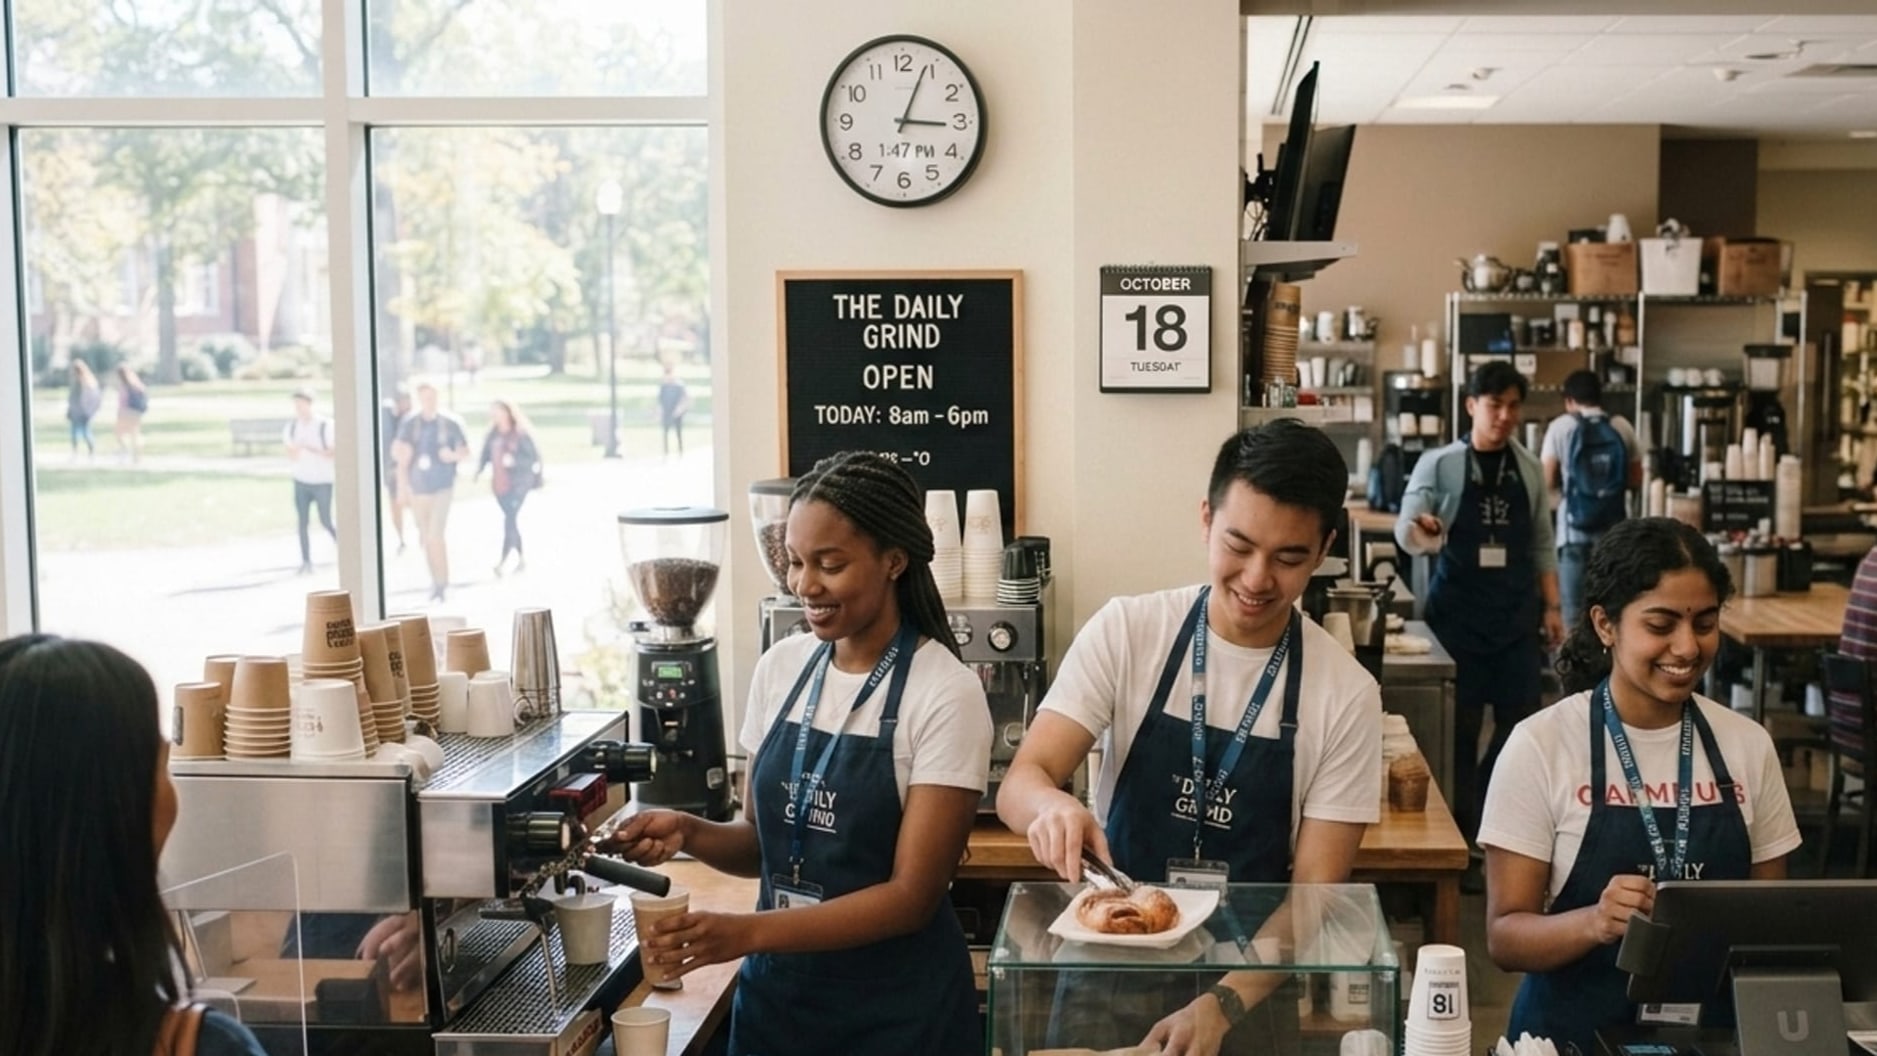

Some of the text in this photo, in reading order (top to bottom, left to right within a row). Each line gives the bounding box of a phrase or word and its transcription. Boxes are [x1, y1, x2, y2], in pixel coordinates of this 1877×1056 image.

[869, 63, 882, 80] 11
[894, 54, 913, 72] 12
[930, 63, 935, 80] 1
[848, 84, 867, 102] 10
[945, 83, 959, 102] 2
[839, 113, 853, 131] 9
[952, 113, 967, 131] 3
[848, 142, 862, 160] 8
[944, 142, 958, 158] 4
[869, 164, 883, 181] 7
[897, 171, 912, 189] 6
[925, 164, 940, 181] 5
[833, 294, 963, 319] THE DAILY
[863, 323, 941, 349] GRIND
[1125, 304, 1188, 352] 18
[863, 364, 934, 389] OPEN
[814, 405, 881, 425] TODAY:
[888, 405, 929, 425] 8am
[947, 405, 989, 429] 6pm
